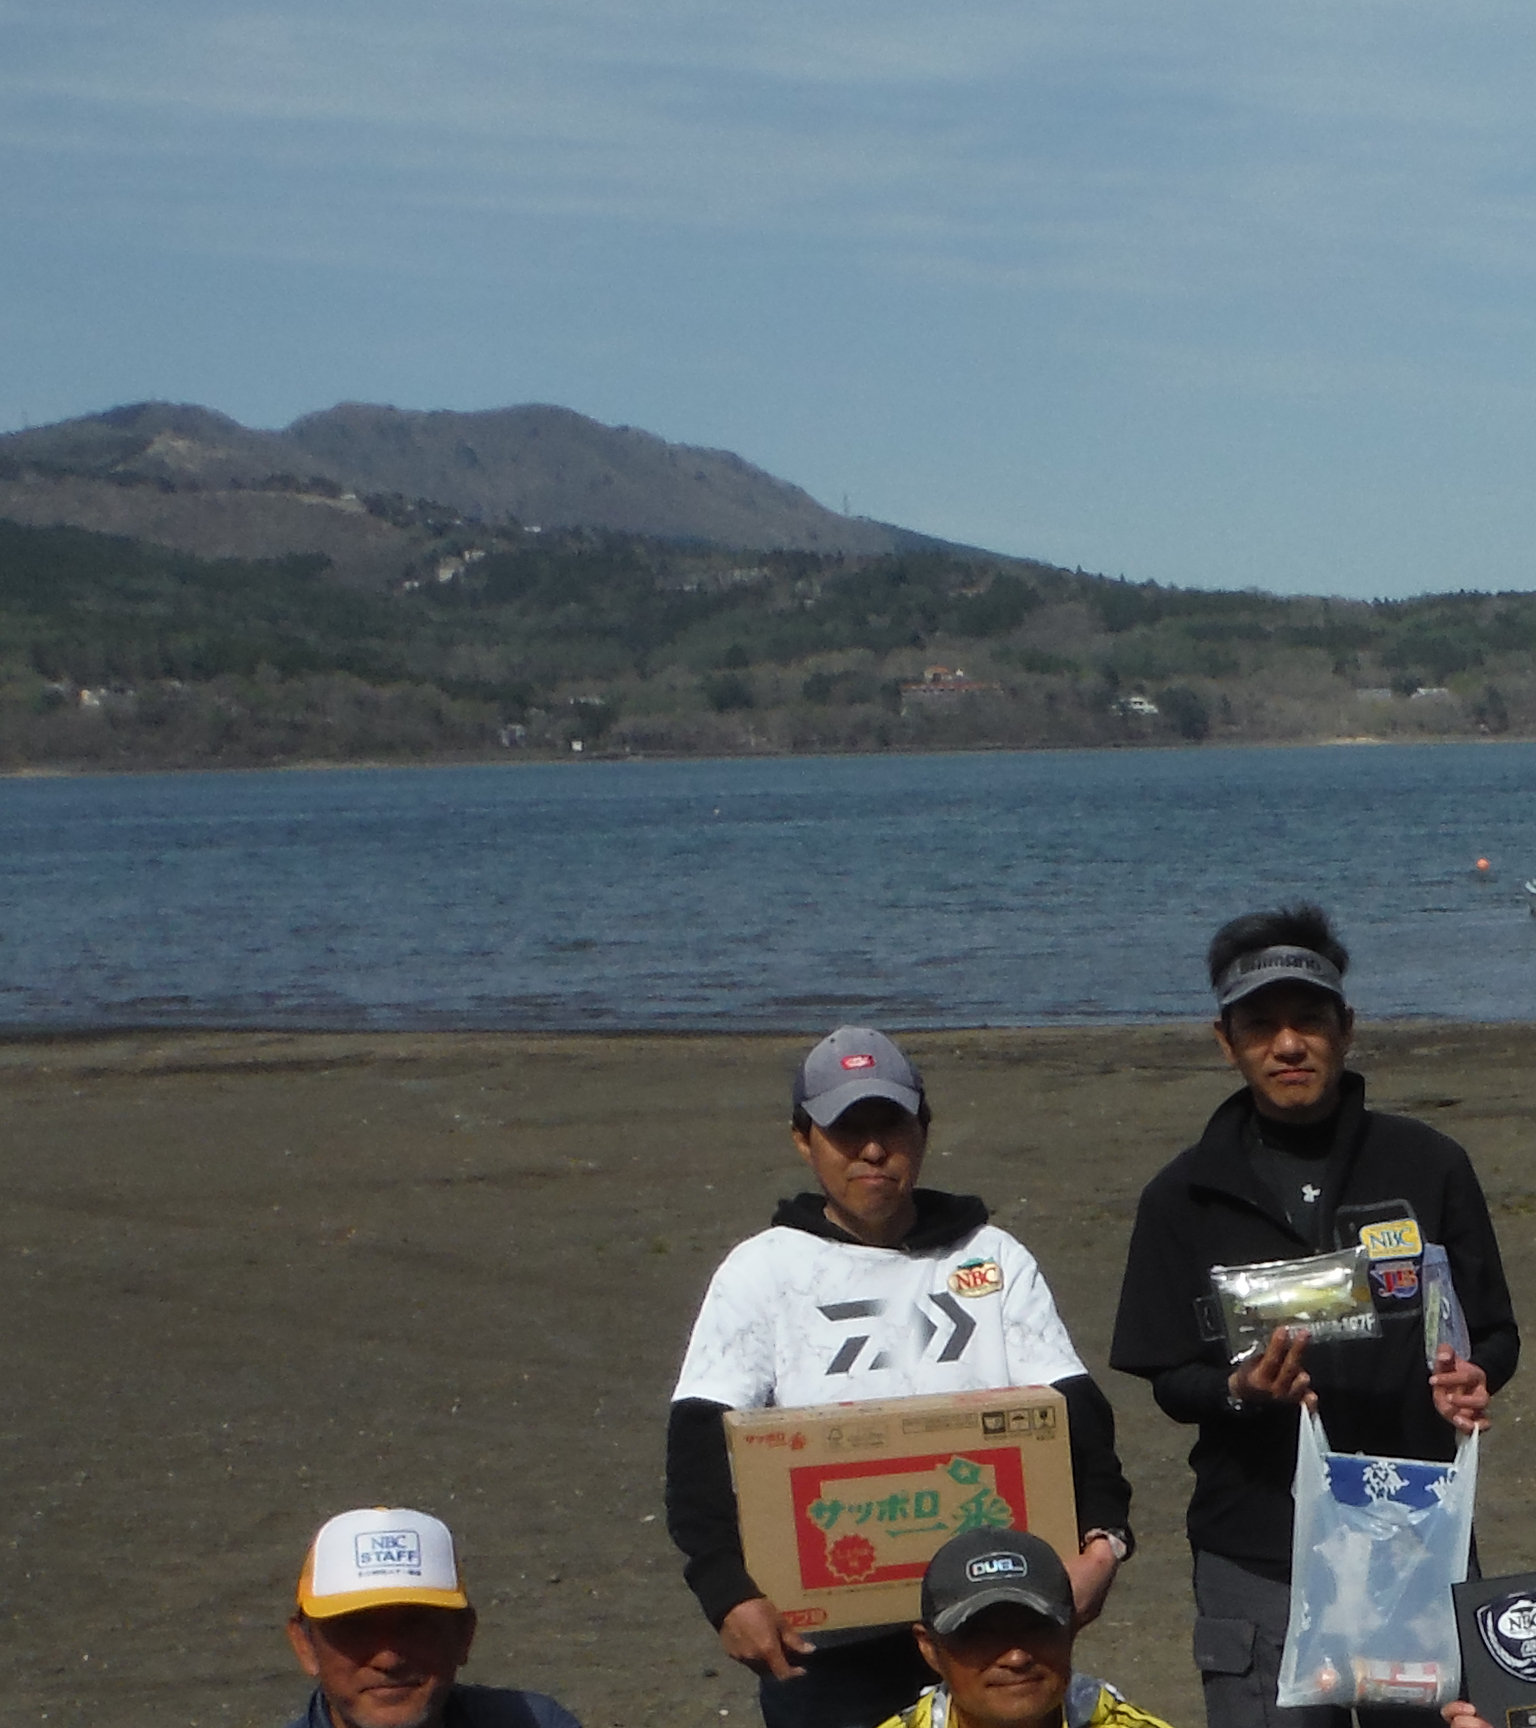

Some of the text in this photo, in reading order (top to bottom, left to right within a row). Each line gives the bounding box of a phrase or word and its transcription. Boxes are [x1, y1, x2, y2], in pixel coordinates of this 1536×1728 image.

[1368, 1227, 1416, 1250] NBC
[954, 1267, 998, 1290] NBC
[371, 1534, 408, 1550] NBC
[360, 1550, 416, 1564] STAFF
